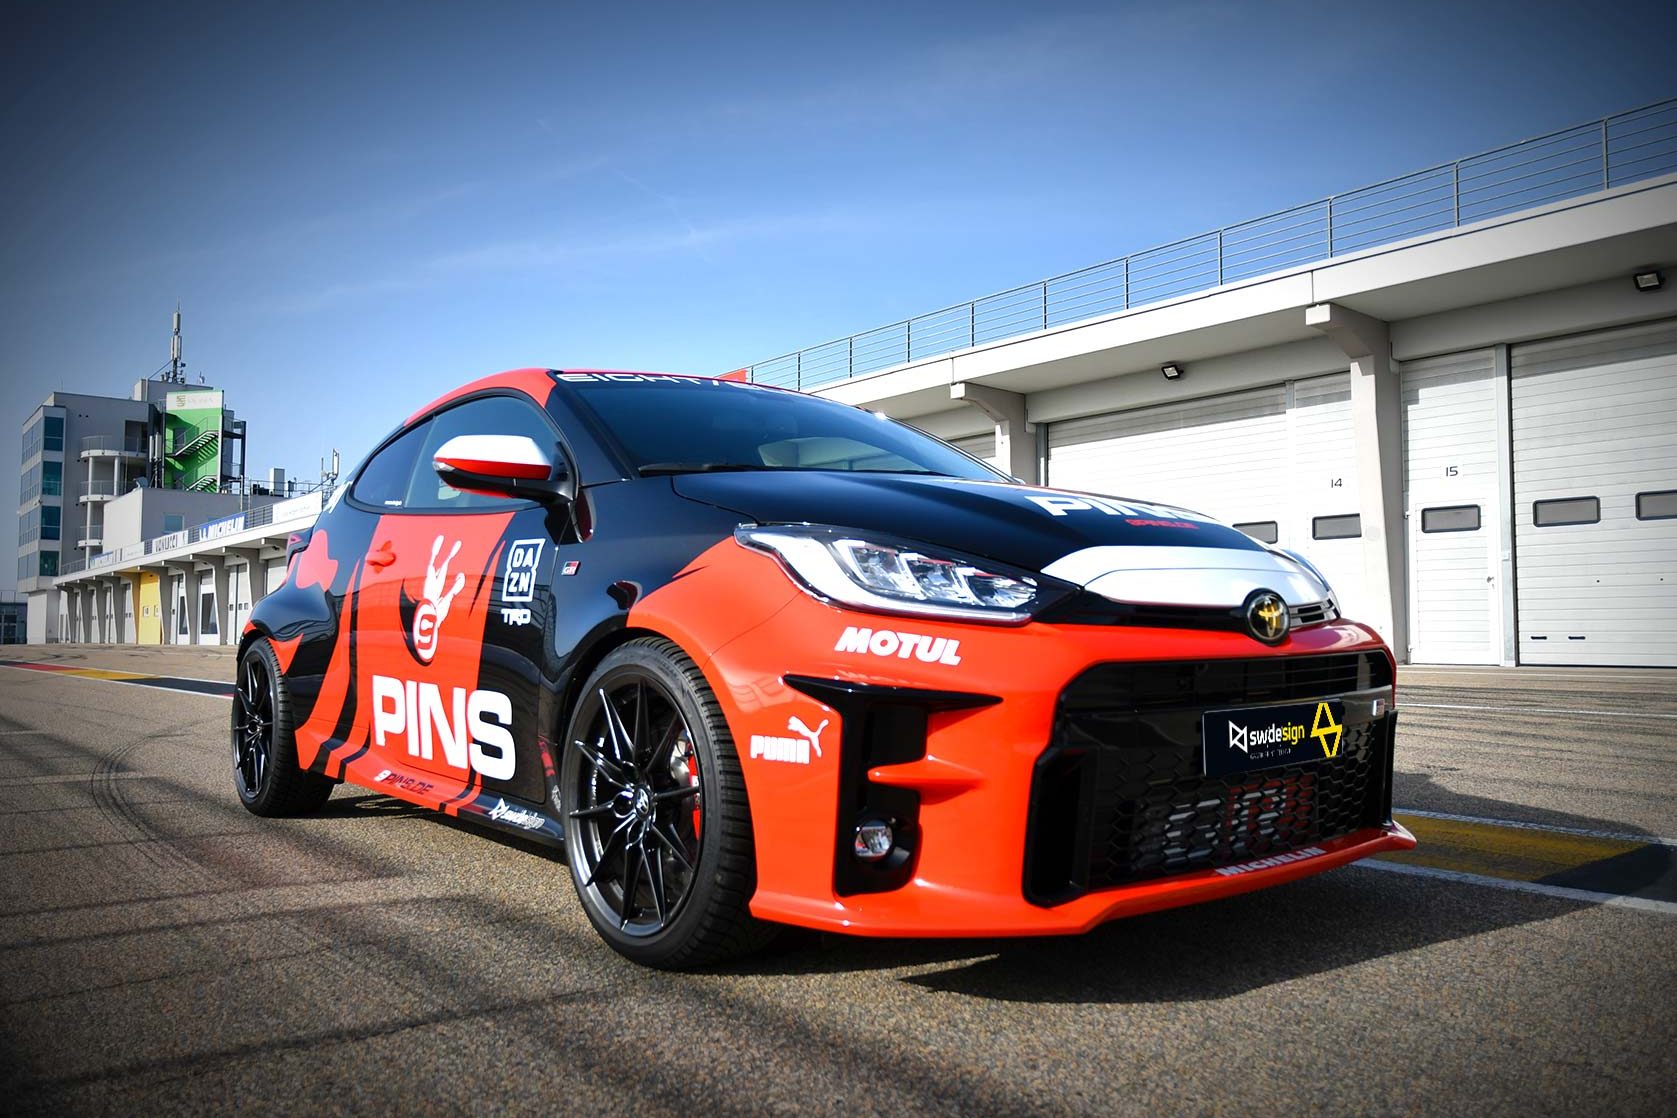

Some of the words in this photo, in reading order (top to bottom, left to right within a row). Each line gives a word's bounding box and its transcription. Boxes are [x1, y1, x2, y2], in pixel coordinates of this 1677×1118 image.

[1330, 478, 1342, 488] 14
[1445, 466, 1458, 477] 15
[834, 626, 962, 666] MOTUL
[371, 675, 516, 781] PINS
[1249, 722, 1305, 746] swdesign
[750, 735, 810, 764] PUMA
[1215, 847, 1327, 876] MICHELIN
